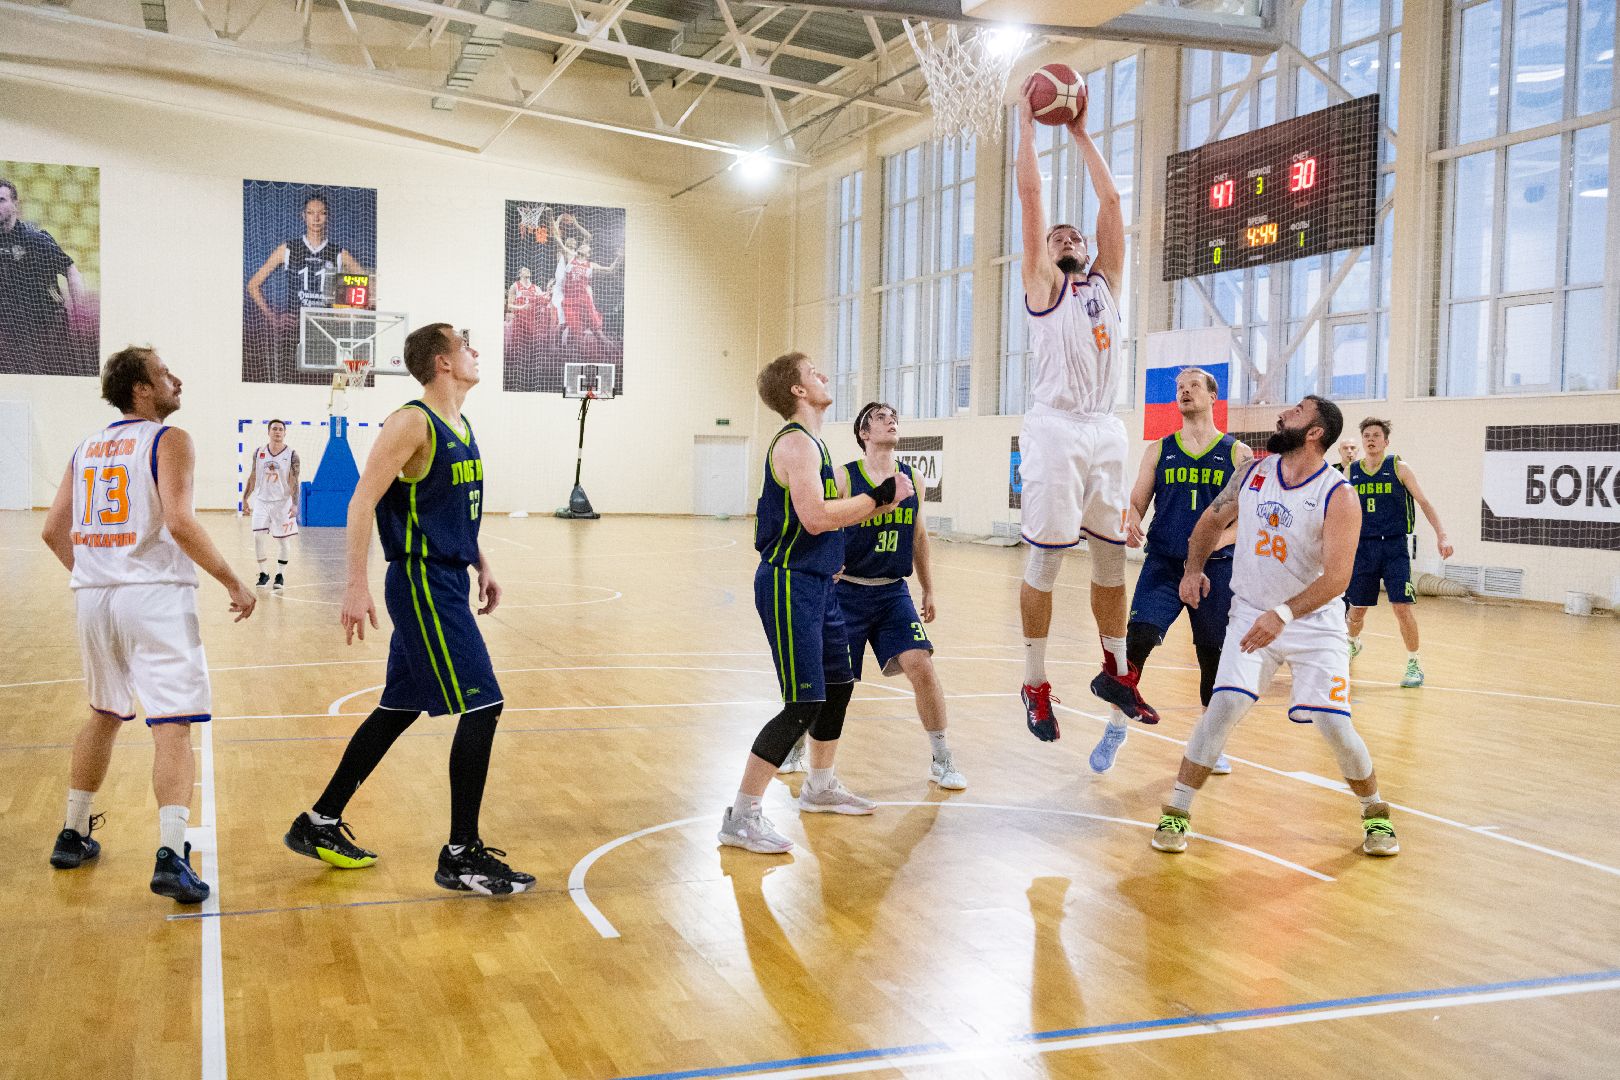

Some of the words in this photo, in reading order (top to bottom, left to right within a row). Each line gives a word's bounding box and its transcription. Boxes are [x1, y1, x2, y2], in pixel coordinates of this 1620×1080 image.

[1292, 151, 1309, 162] СЧЕТ
[1291, 158, 1315, 192] 30
[1213, 180, 1234, 208] 47
[1255, 176, 1263, 195] 3
[1247, 223, 1278, 247] 4:44
[1300, 231, 1304, 247] 1
[1213, 247, 1221, 265] 0
[298, 266, 326, 292] 11
[344, 275, 368, 286] 4:44
[351, 287, 366, 305] 13
[265, 472, 279, 483] 77
[81, 463, 132, 526] 13
[1191, 490, 1197, 510] 1
[1367, 498, 1375, 512] 8
[875, 530, 898, 552] 30
[1255, 529, 1288, 564] 28
[1329, 675, 1352, 704] 2
